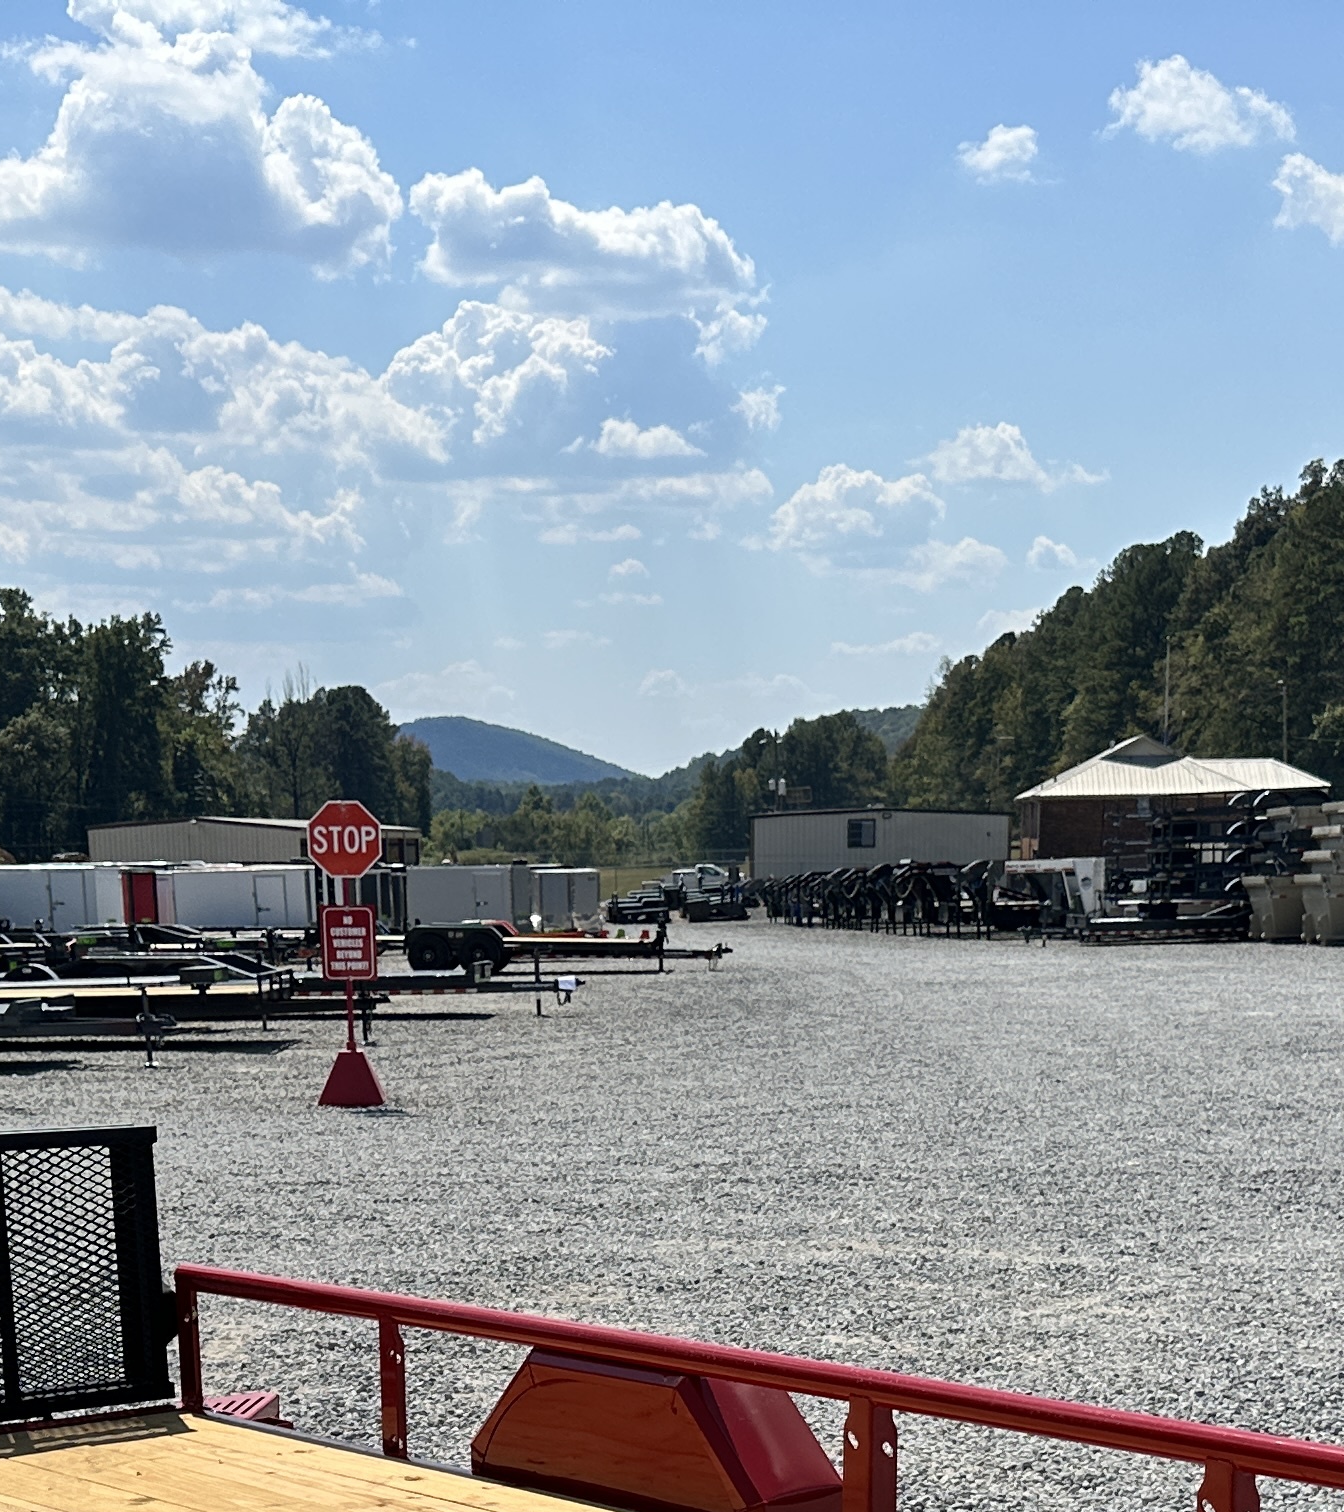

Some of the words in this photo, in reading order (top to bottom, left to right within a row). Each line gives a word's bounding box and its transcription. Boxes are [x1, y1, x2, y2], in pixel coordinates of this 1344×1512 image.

[312, 825, 377, 854] STOP
[342, 915, 353, 925] NO
[330, 927, 366, 937] CUSTOMER
[332, 938, 364, 948] VEHICLES
[336, 950, 362, 959] BEYOND
[330, 961, 346, 970] THIS
